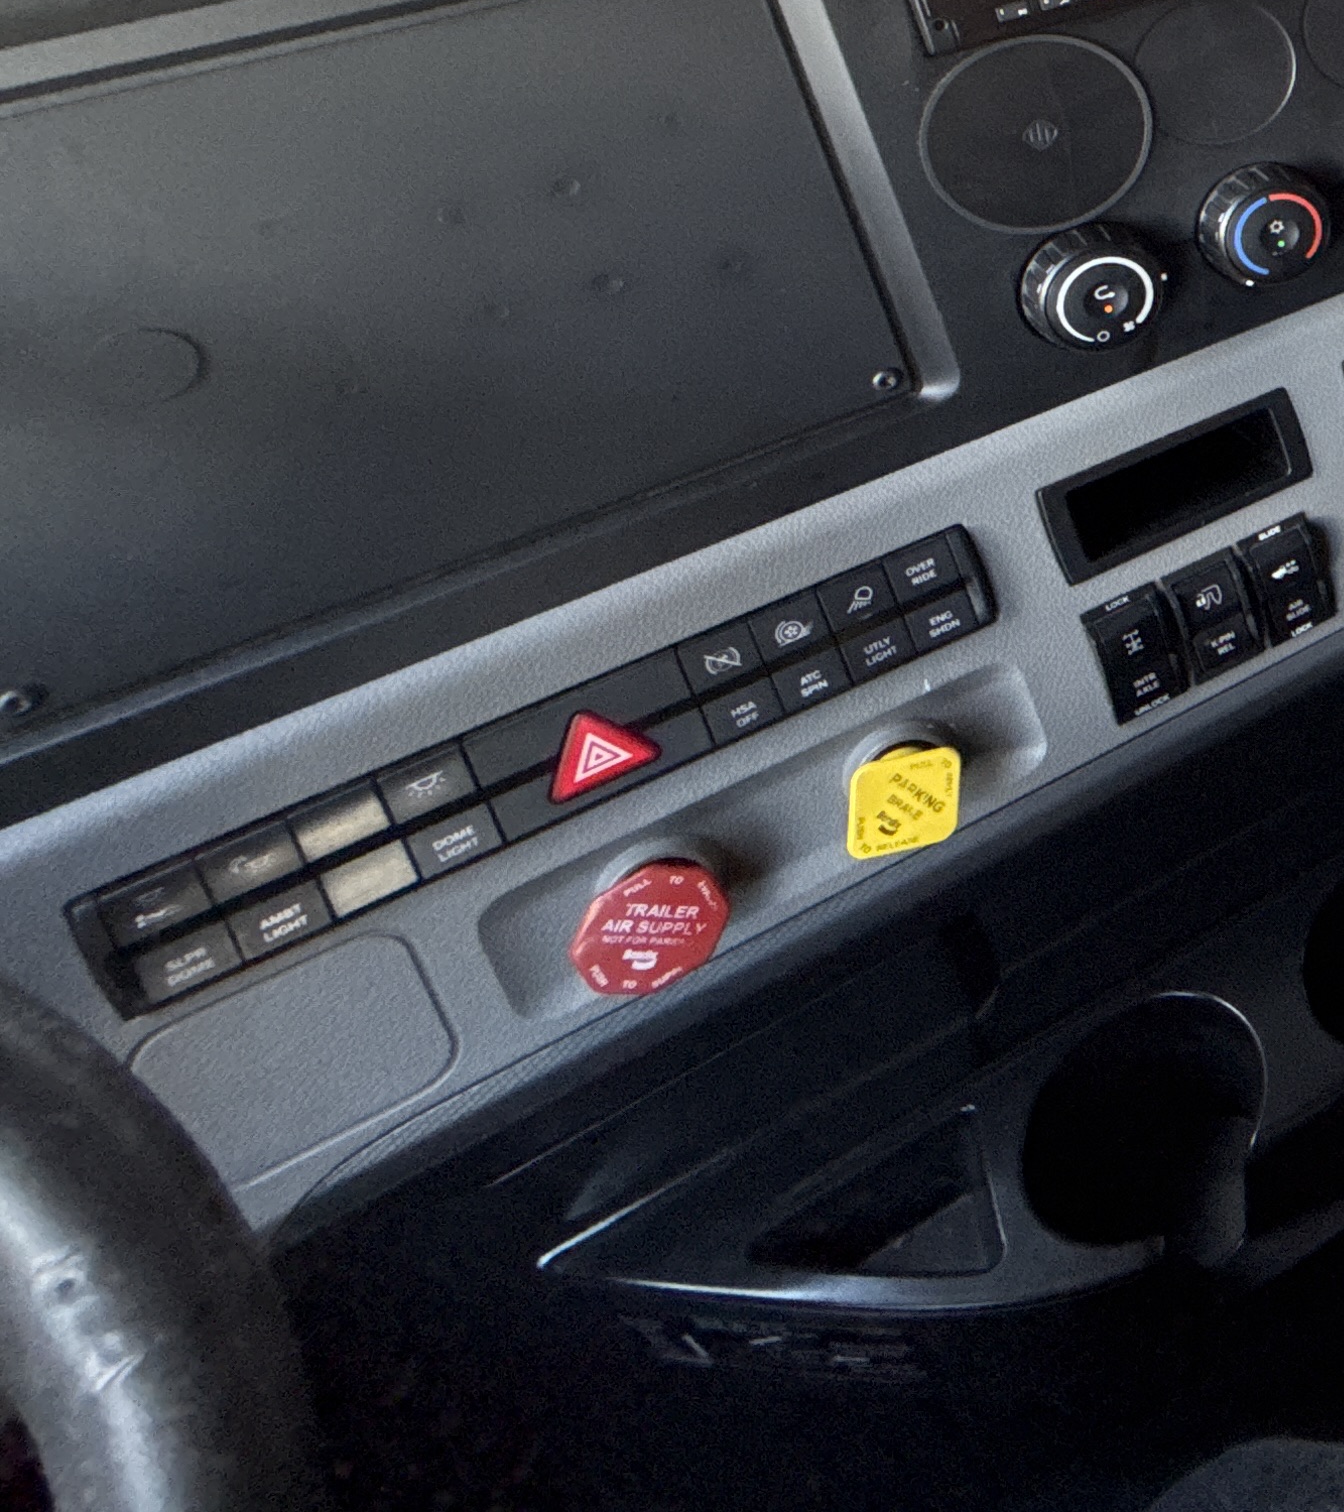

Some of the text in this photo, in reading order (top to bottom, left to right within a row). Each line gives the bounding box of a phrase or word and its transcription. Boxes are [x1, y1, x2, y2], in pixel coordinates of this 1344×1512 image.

[905, 557, 936, 578] OVER
[911, 569, 938, 586] RIDE
[1105, 595, 1130, 612] LOCK
[929, 610, 953, 627] ENG
[1290, 621, 1314, 638] LOCK
[863, 636, 892, 656] UTLY
[866, 645, 898, 667] LIGHT
[800, 669, 821, 686] ATC
[800, 679, 829, 698] SPIN
[730, 701, 758, 719] HSA
[736, 711, 760, 728] OFF
[888, 772, 947, 814] PARKING
[886, 793, 924, 821] BRAKE
[432, 824, 476, 852] DOME
[438, 836, 480, 862] LIGHT
[626, 903, 700, 919] TRAILER
[263, 914, 309, 942] LIGHT
[601, 919, 707, 936] AIR SUPPLY
[601, 935, 624, 945] NOT
[622, 980, 638, 989] TO
